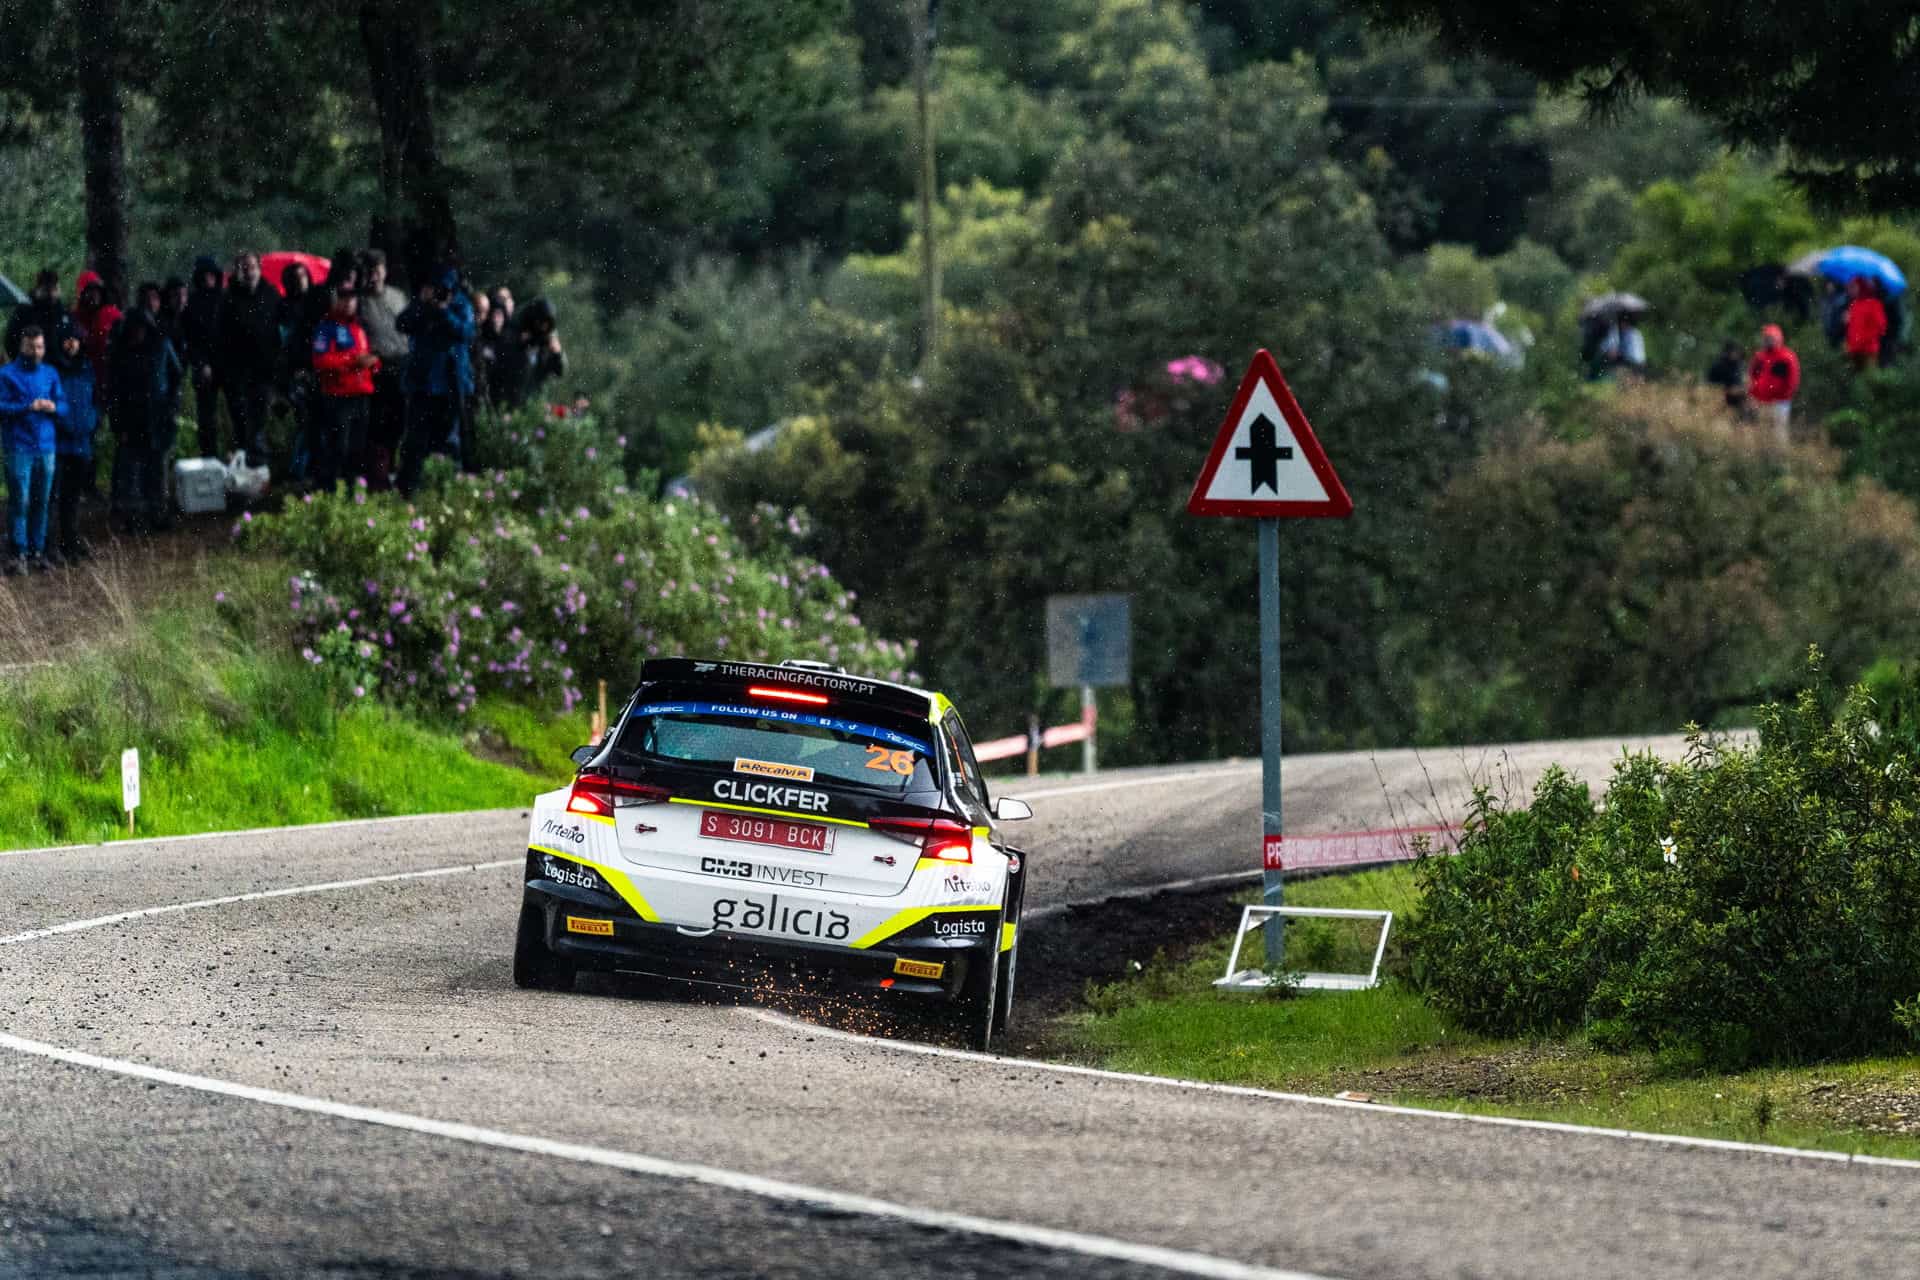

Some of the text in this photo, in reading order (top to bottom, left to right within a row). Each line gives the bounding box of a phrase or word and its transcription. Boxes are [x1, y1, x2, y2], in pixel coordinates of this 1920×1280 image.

[720, 663, 876, 695] THERACINGFACTORY.PT
[711, 704, 798, 720] FOLLOW US ON
[751, 763, 797, 777] Recalvi
[865, 745, 916, 776] 26
[713, 779, 830, 812] CLICKFER
[541, 819, 585, 844] Arteixo
[706, 815, 718, 832] S
[729, 818, 774, 840] 3091
[787, 825, 823, 847] BCK
[544, 861, 593, 889] Logista
[701, 856, 830, 887] CM3 INVEST
[944, 876, 992, 892] Artexo
[712, 894, 850, 940] galicia
[933, 919, 985, 937] Logista
